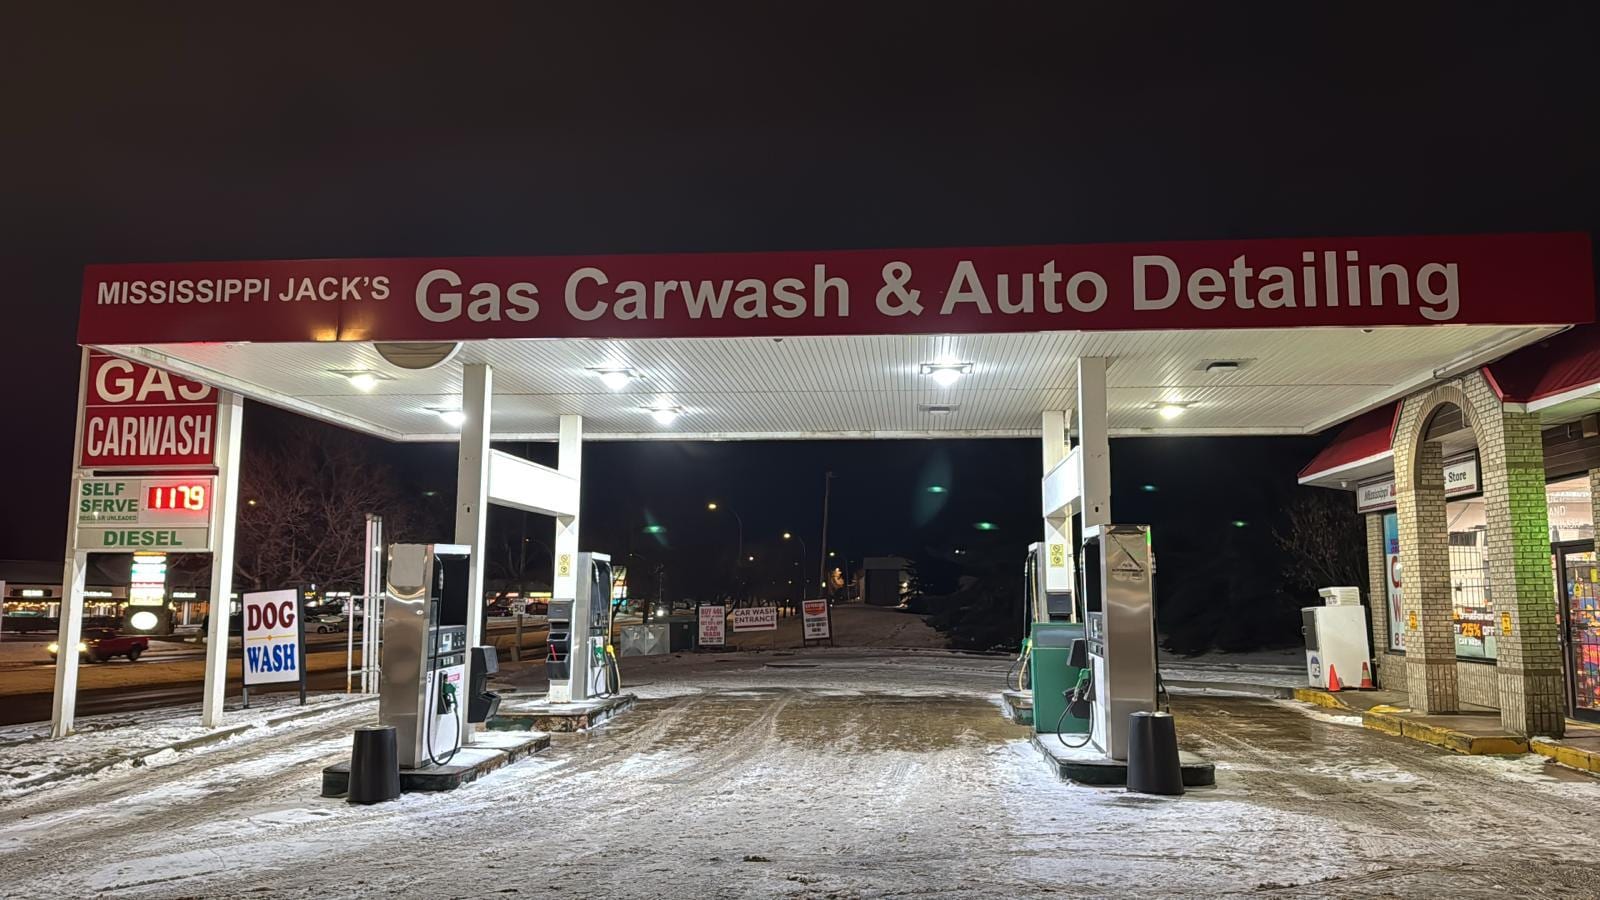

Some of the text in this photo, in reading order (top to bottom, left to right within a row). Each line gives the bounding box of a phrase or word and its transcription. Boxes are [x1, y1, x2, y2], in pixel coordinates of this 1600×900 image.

[97, 276, 391, 305] MISSISSIPPI JACK'S
[415, 250, 1460, 323] Gas Carwash & Auto Detailing
[87, 414, 212, 457] CARWASH
[1448, 471, 1467, 483] Store
[82, 482, 125, 496] SELF
[80, 499, 139, 513] SERVE
[155, 485, 205, 511] 1179
[103, 530, 183, 547] DIESEL
[247, 601, 295, 631] DOG
[514, 604, 525, 613] 50
[734, 607, 775, 617] CAR WASH
[735, 615, 775, 623] ENTRANCE
[1461, 622, 1481, 637] 25%
[247, 643, 296, 674] WASH
